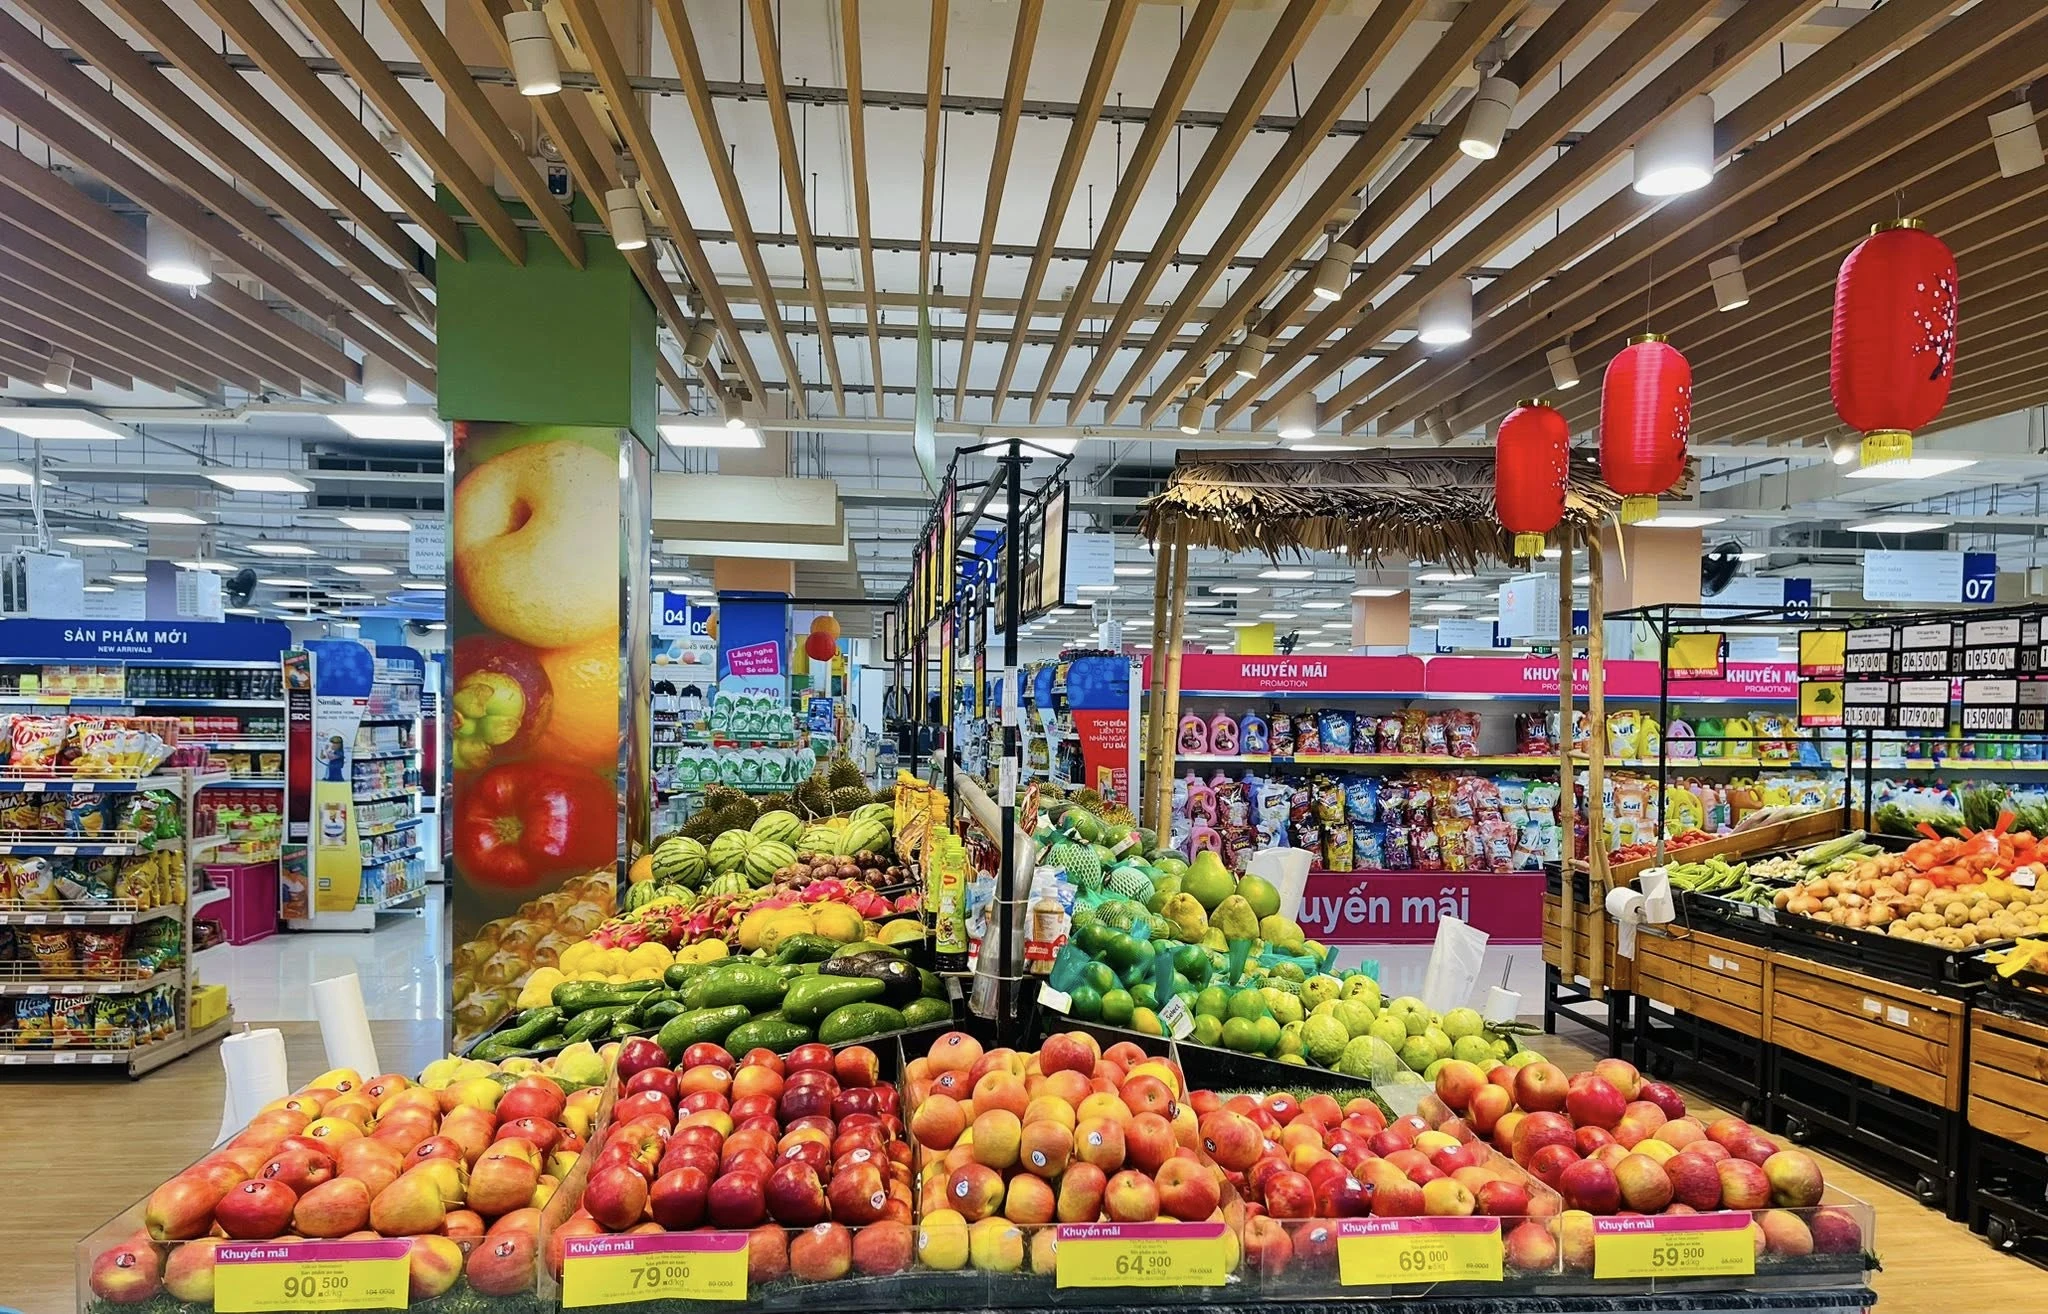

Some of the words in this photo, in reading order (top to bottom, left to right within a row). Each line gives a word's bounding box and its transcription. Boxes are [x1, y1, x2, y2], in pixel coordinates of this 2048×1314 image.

[1966, 579, 1993, 599] 07
[665, 610, 684, 624] 04
[693, 622, 708, 634] 05
[1573, 626, 1588, 635] 10
[64, 628, 95, 642] SẢN
[102, 627, 148, 643] PHẨM
[154, 629, 187, 644] MỚI
[753, 648, 773, 656] nghe
[1968, 652, 2005, 667] 19.500
[1242, 660, 1297, 677] KHUYẾN
[1302, 661, 1327, 677] MÃI
[1523, 667, 1577, 681] KHUYN
[1582, 668, 1606, 682] MI
[1726, 666, 1781, 683] KHUYẾN
[1744, 685, 1791, 693] PROMOTION
[1093, 719, 1109, 727] TÍCH
[1109, 719, 1127, 727] ĐIỂM
[1966, 711, 2003, 725] 15.900
[1623, 801, 1640, 810] Surf
[1298, 882, 1390, 934] uyến
[1402, 887, 1470, 923] mãi
[1062, 1226, 1100, 1238] Khuyến
[1102, 1226, 1121, 1236] mãi
[1342, 1221, 1379, 1234] Khuyến
[1381, 1221, 1399, 1231] mãi
[1598, 1220, 1636, 1232] Khuyến
[1637, 1219, 1655, 1229] mãi
[571, 1238, 612, 1254] Khuyến
[614, 1239, 634, 1251] mãi
[221, 1247, 265, 1261] Khuyến
[267, 1247, 289, 1258] mãi
[1429, 1250, 1448, 1261] 000
[1683, 1248, 1704, 1258] 900
[1149, 1256, 1172, 1267] 900
[665, 1266, 690, 1278] 000
[322, 1276, 349, 1289] 500
